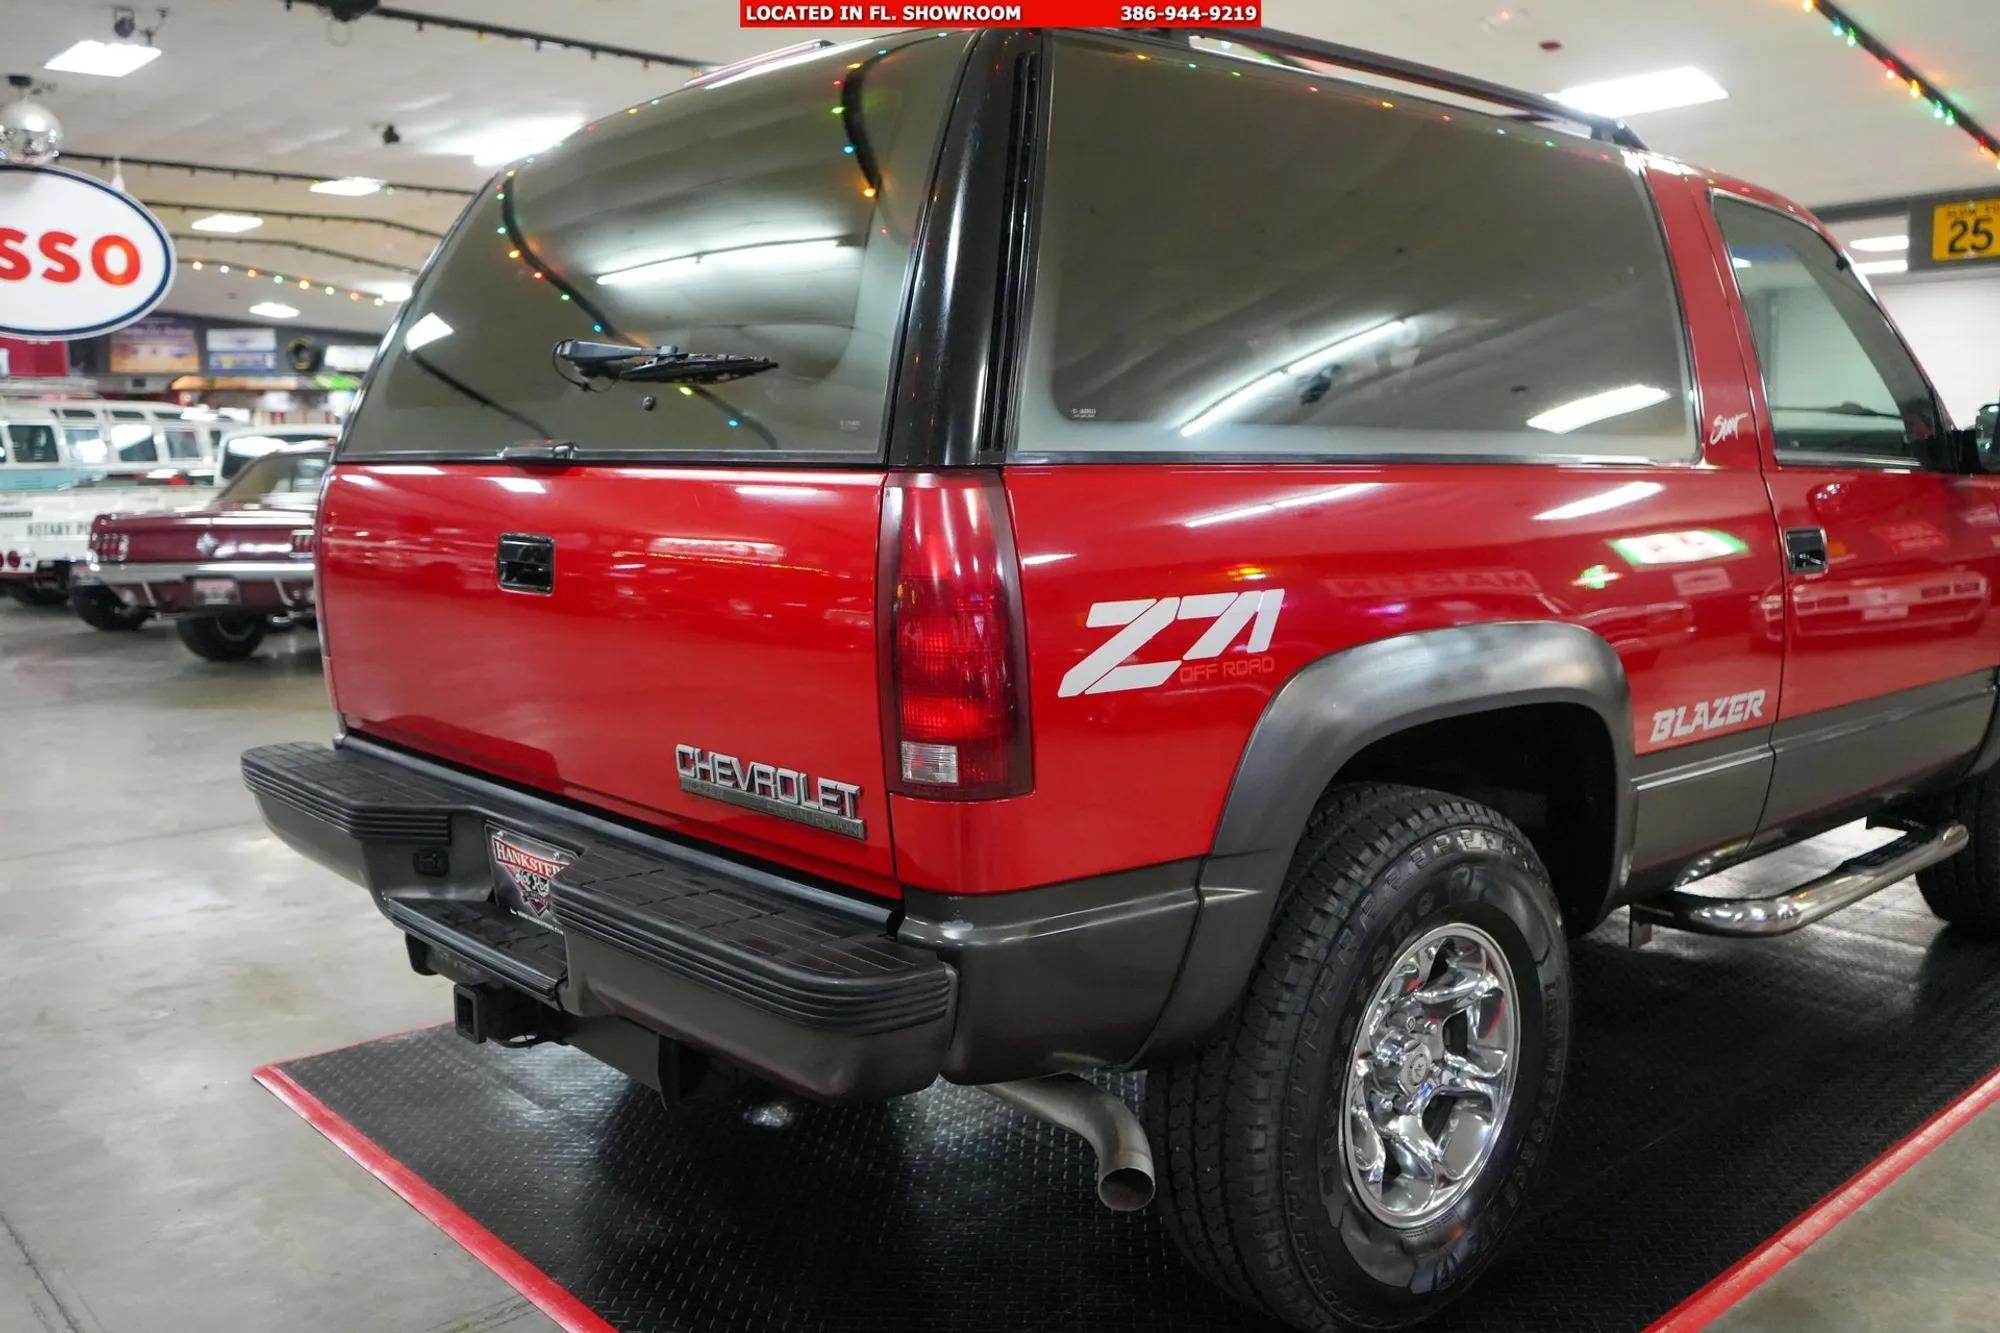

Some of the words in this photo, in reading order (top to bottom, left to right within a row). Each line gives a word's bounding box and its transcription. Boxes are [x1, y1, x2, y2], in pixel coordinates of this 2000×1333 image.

[1948, 216, 1994, 253] 25
[1057, 588, 1286, 698] Z71
[1179, 663, 1219, 683] OFF
[1222, 656, 1276, 678] ROAD
[1649, 688, 1766, 743] BLAZER
[675, 743, 862, 819] CHEVROLET
